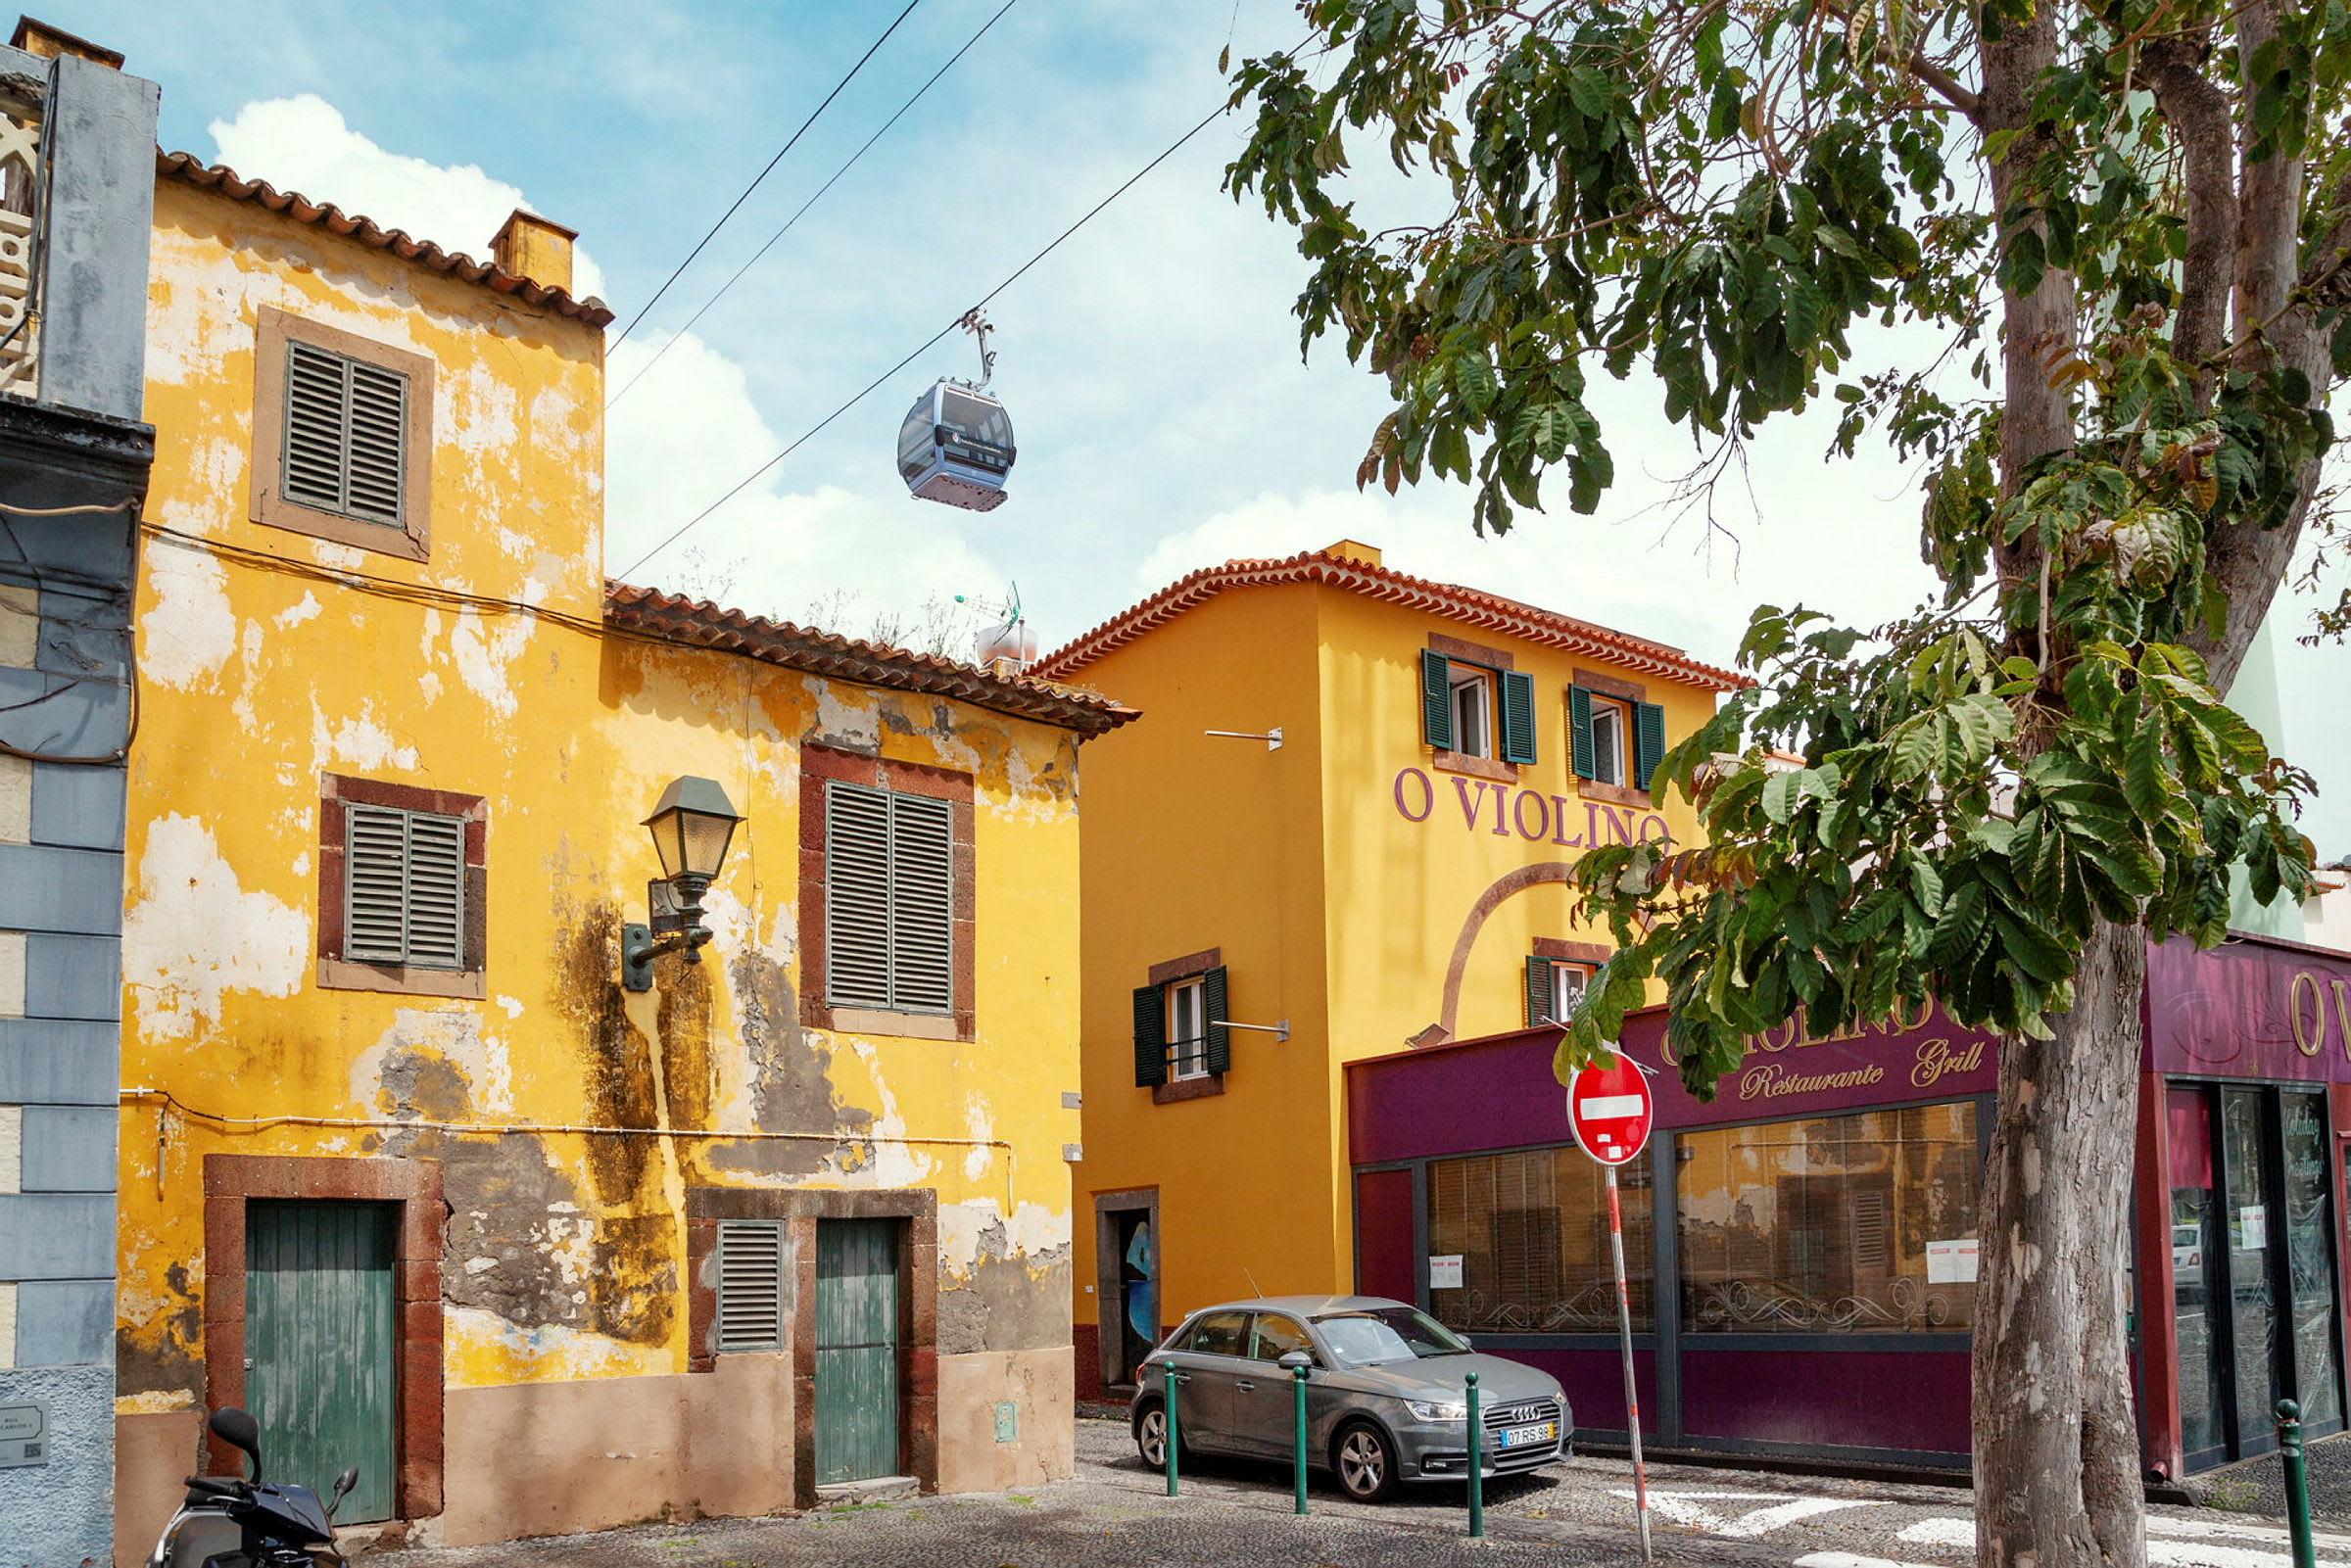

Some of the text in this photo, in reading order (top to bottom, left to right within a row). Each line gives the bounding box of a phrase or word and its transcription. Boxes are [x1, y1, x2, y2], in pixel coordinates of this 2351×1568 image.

[1394, 767, 1670, 858] O VIOLINO
[2290, 971, 2326, 1057] O
[1739, 1038, 1986, 1101] Restaurante Grill
[1509, 1432, 1520, 1445] 07
[1522, 1429, 1537, 1443] RS
